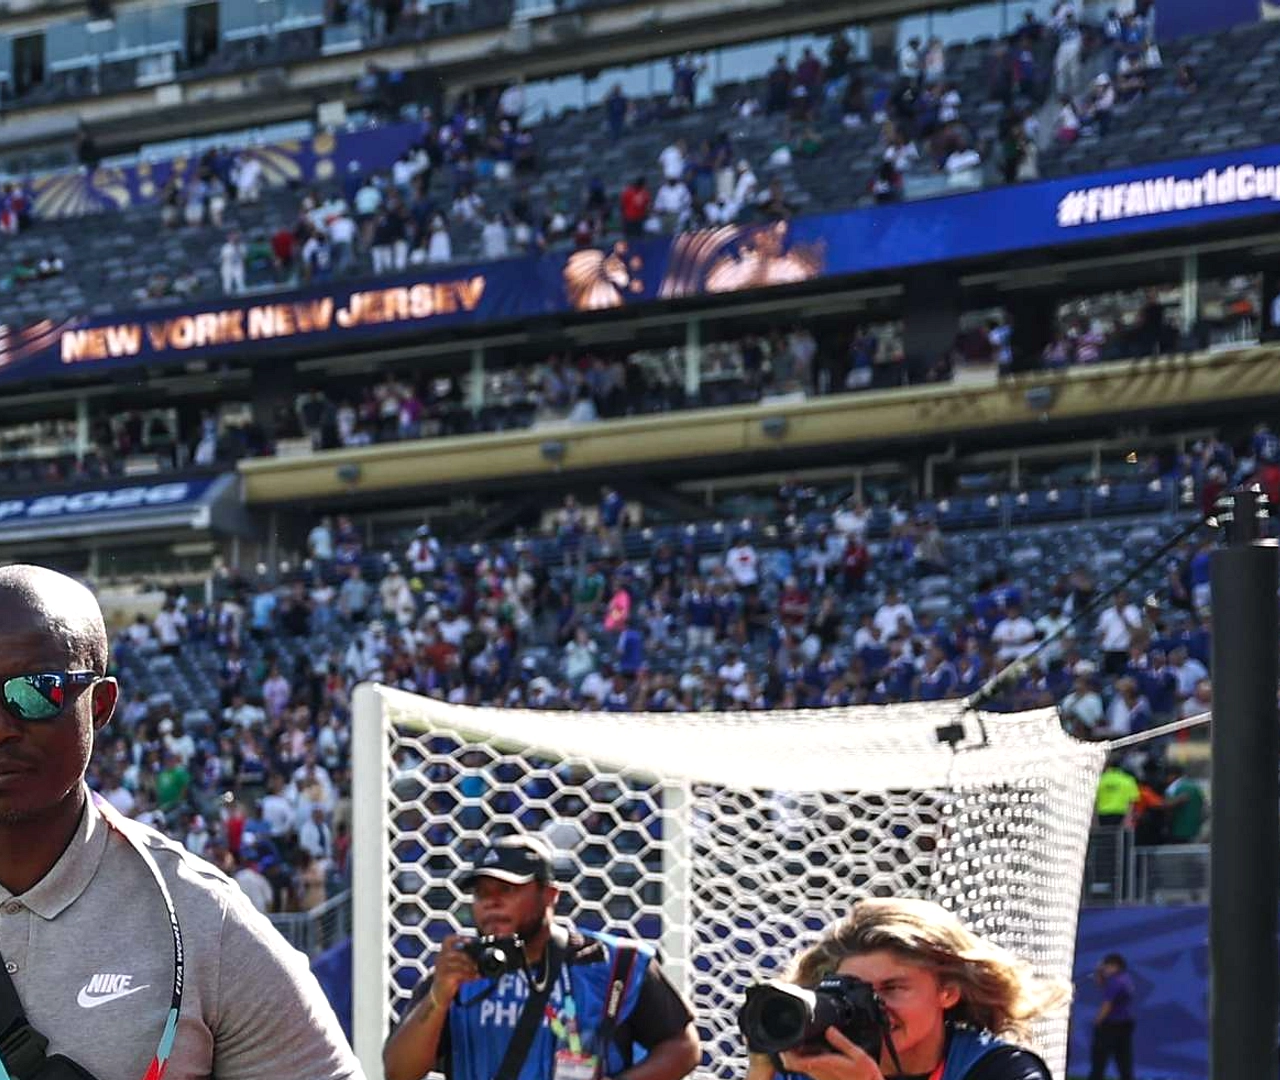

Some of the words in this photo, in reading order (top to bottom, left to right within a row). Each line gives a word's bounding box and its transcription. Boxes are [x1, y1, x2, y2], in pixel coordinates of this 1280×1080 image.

[1057, 163, 1280, 228] #FIFAWorldCu
[61, 323, 140, 363] NEW
[146, 309, 245, 352] YORK
[247, 297, 335, 341] NEW
[336, 275, 486, 329] JERSEY
[27, 483, 189, 517] 2026
[86, 974, 134, 994] NIKE
